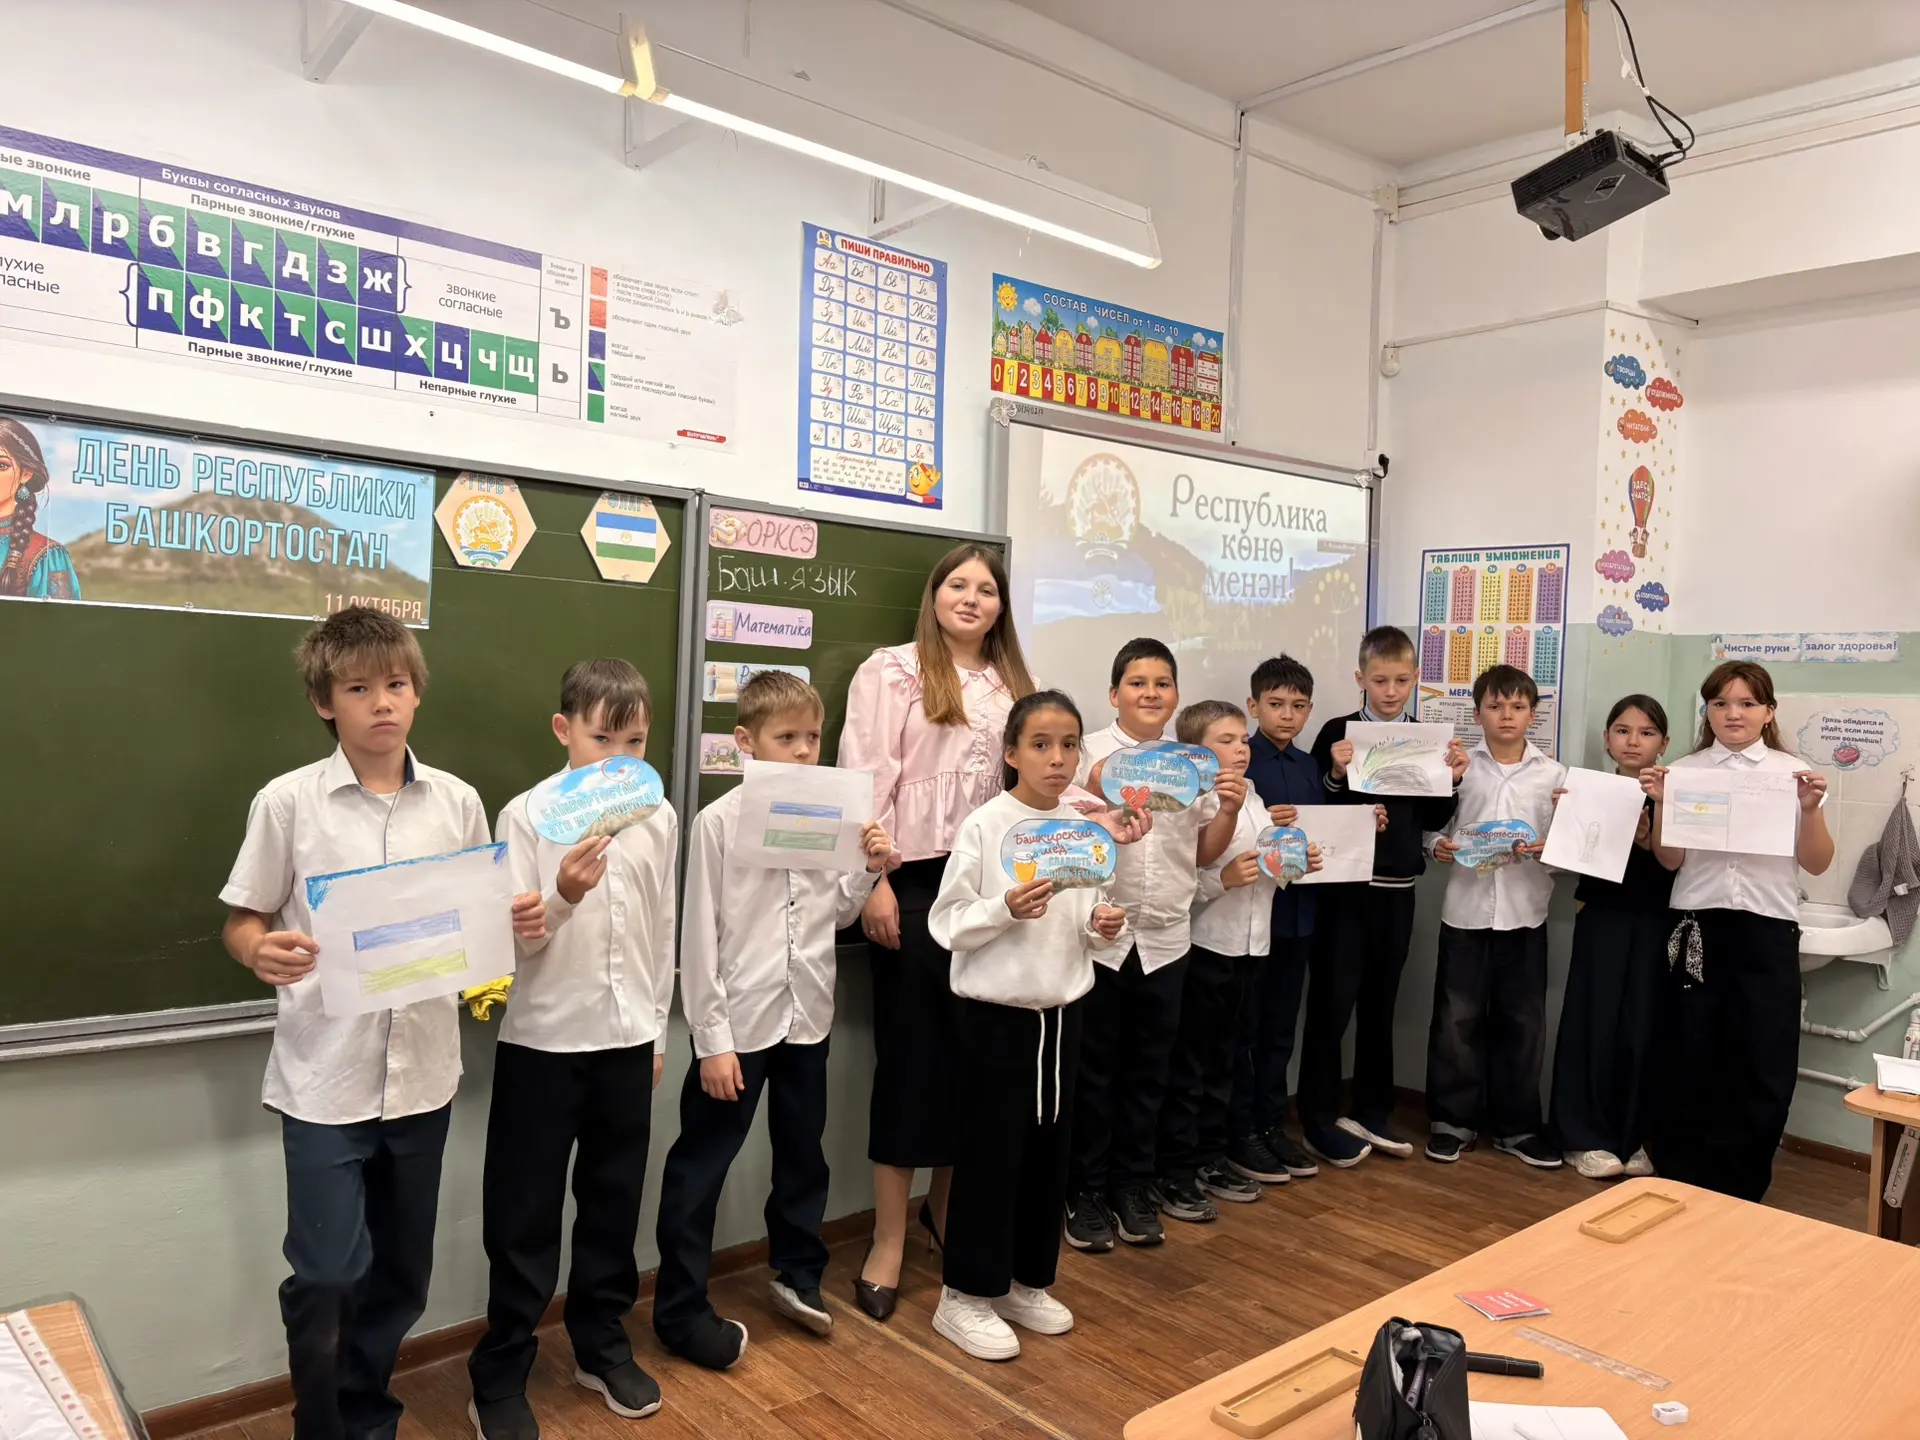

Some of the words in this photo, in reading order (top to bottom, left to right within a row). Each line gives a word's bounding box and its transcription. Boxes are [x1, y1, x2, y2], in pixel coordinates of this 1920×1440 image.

[27, 158, 91, 181] звонкие
[161, 168, 209, 189] Буквы
[213, 181, 291, 208] согласных
[293, 199, 341, 219] звуков
[191, 194, 246, 216] Парные
[248, 207, 356, 241] звонкие/глухие
[0, 189, 33, 220] м
[50, 200, 80, 230] л
[103, 210, 130, 244] р
[148, 214, 176, 247] б
[197, 231, 221, 257] в
[243, 239, 264, 264] г
[282, 250, 309, 282] д
[327, 259, 348, 283] з
[363, 266, 393, 295] ж
[841, 239, 871, 255] ПИШИ
[873, 250, 930, 273] ПРАВИЛЬНО
[438, 297, 503, 319] согласные
[446, 284, 496, 302] звонкие
[1043, 292, 1088, 314] СОСТАВ
[1094, 305, 1130, 324] ЧИСЕЛ
[1132, 318, 1143, 327] от
[1146, 319, 1151, 328] 1
[1154, 324, 1166, 334] до
[1168, 325, 1179, 337] 10
[148, 286, 173, 313] п
[189, 288, 224, 327] ф
[240, 304, 263, 330] к
[284, 312, 305, 337] т
[325, 320, 346, 345] с
[361, 327, 391, 352] ш
[404, 334, 428, 359] х
[441, 341, 462, 370] ц
[479, 351, 497, 371] ч
[509, 354, 534, 383] щ
[188, 341, 242, 362] Парные
[246, 351, 353, 378] звонкие/глухие
[419, 380, 477, 401] Непарные
[479, 388, 517, 406] глухие
[993, 363, 1002, 382] 0
[1007, 366, 1015, 385] 1
[1019, 368, 1028, 388] 2
[1031, 369, 1041, 390] 3
[1043, 371, 1052, 391] 4
[1055, 373, 1064, 394] 5
[1067, 377, 1075, 396] 6
[1078, 379, 1086, 399] 7
[1089, 381, 1097, 400] 8
[1099, 382, 1108, 403] 9
[1110, 385, 1120, 405] 10
[1120, 387, 1129, 408] 11
[1130, 389, 1140, 409] 12
[1140, 391, 1150, 412] 13
[1151, 393, 1160, 414] 14
[1160, 395, 1171, 415] 15
[1172, 396, 1181, 417] 16
[1182, 398, 1191, 420] 17
[1192, 400, 1201, 421] 18
[1201, 402, 1211, 423] 19
[1211, 406, 1220, 425] 20
[73, 438, 181, 490] ДЕНЬ
[192, 453, 416, 520] РЕСПУБЛИКИ
[469, 473, 504, 494] ГЕРБ
[607, 493, 644, 512] ФЛАГ
[1169, 474, 1328, 534] Республика
[106, 502, 389, 570] БАШКОРТОСТАН
[747, 519, 815, 553] ОРКСЭ
[1430, 553, 1480, 563] ТАБЛИЦА
[1485, 550, 1560, 562] УМНОЖЕНИЯ
[789, 567, 857, 597] язык
[325, 593, 343, 612] 11
[735, 611, 811, 637] Математика
[1724, 643, 1762, 653] Чистые
[1764, 644, 1790, 654] руки
[1805, 642, 1836, 651] залог
[1838, 640, 1897, 652] здоровья!
[1822, 716, 1842, 725] Грязь
[1843, 718, 1877, 727] обидится
[1013, 828, 1095, 846] Башкирский
